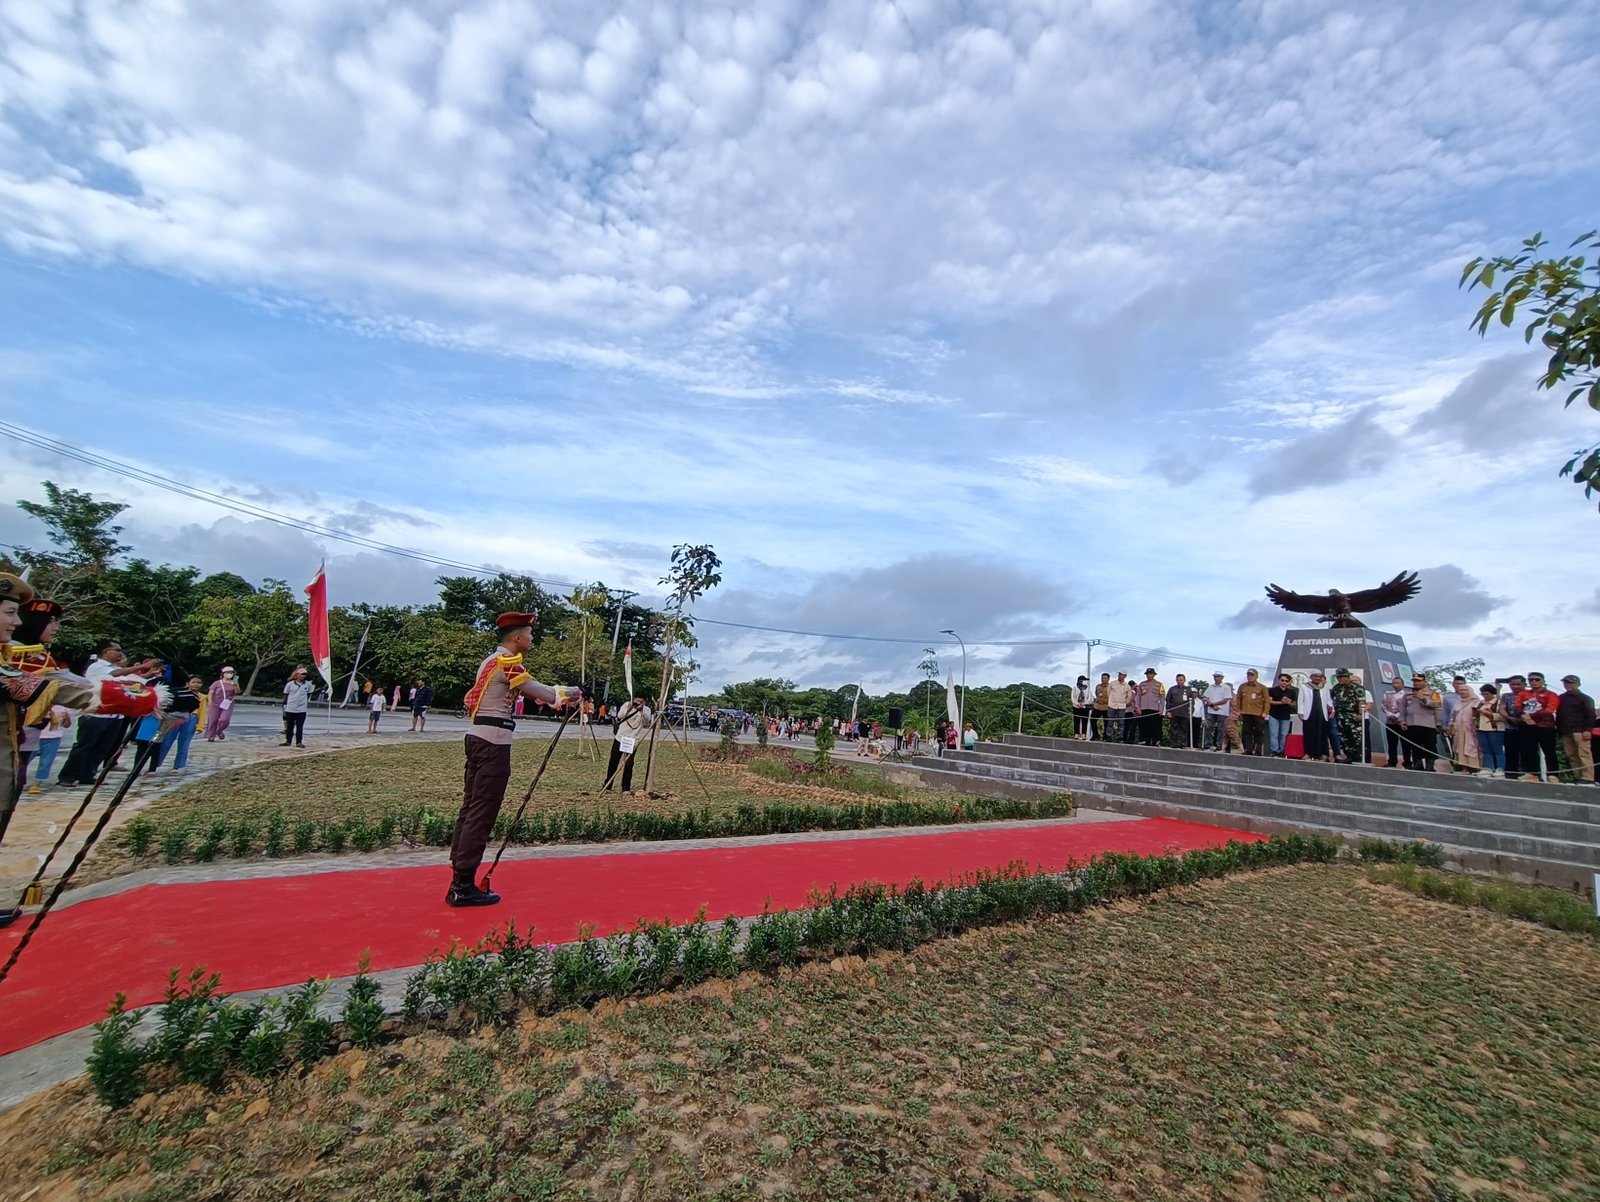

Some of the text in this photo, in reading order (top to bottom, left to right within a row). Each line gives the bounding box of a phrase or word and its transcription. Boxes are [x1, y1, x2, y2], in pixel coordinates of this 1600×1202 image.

[1286, 637, 1363, 646] LATSITARDA NUS
[1309, 647, 1334, 655] XLIV
